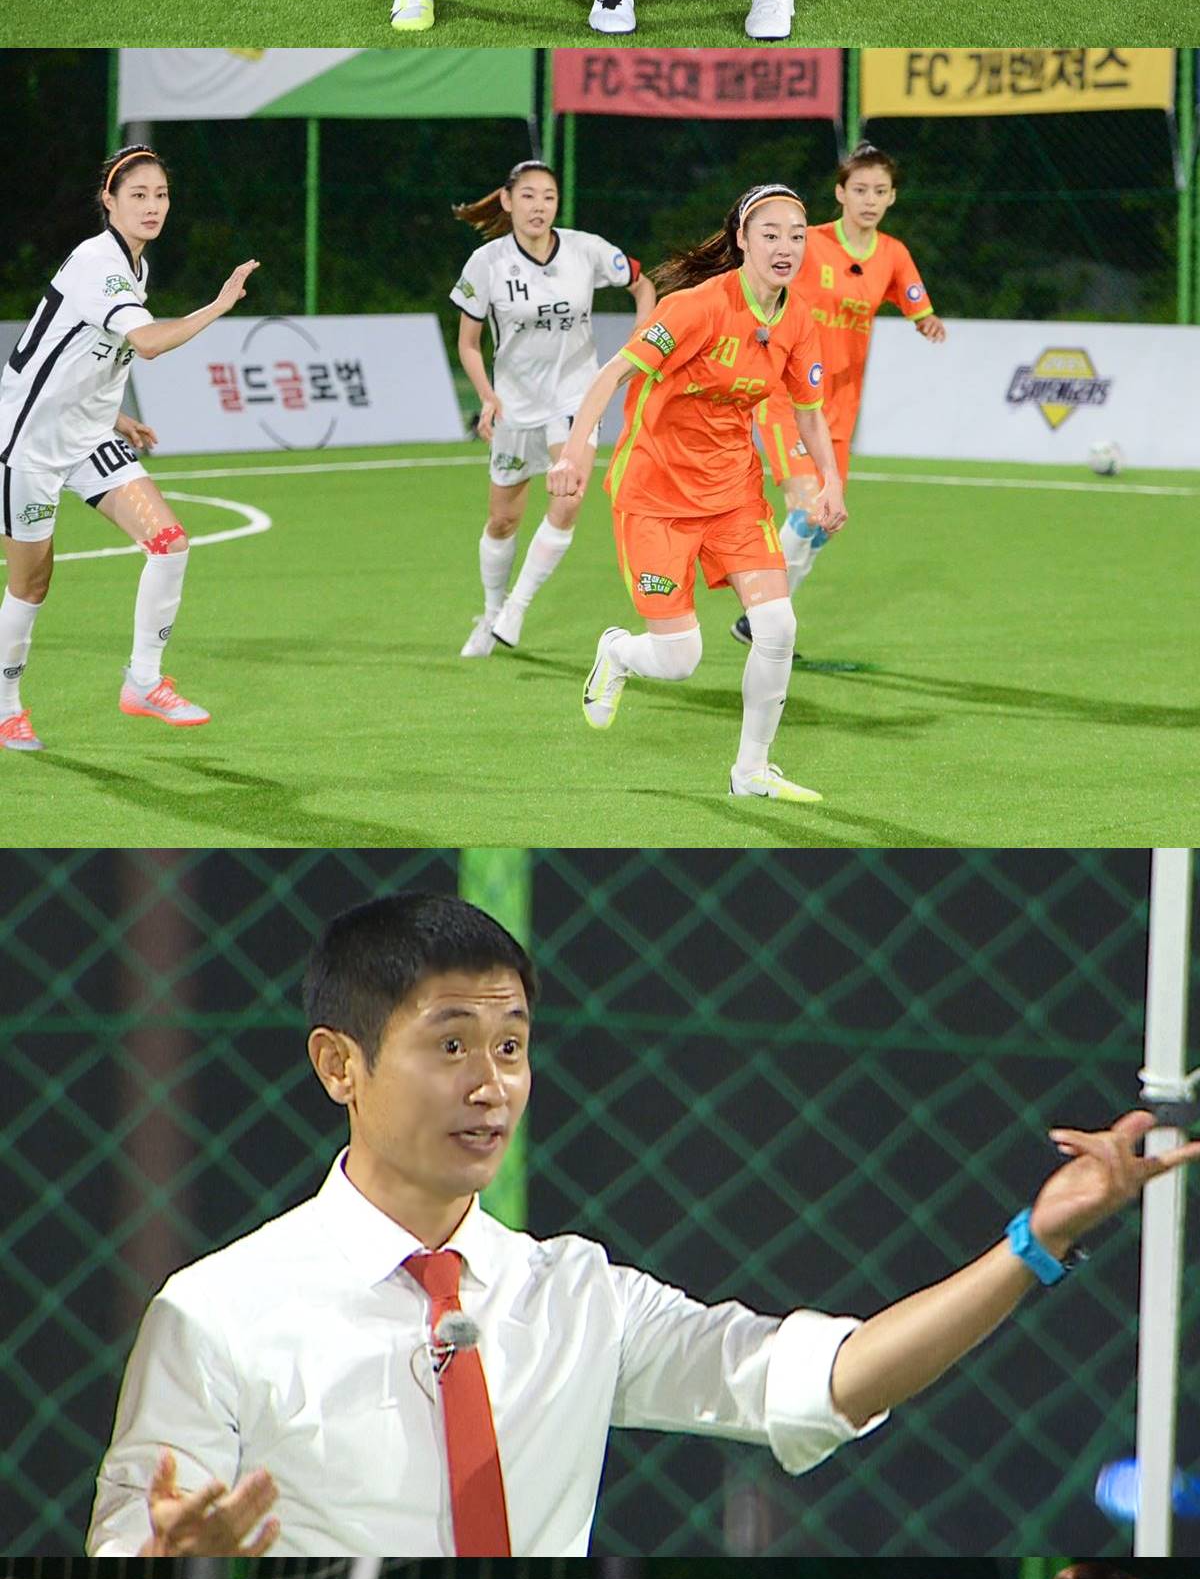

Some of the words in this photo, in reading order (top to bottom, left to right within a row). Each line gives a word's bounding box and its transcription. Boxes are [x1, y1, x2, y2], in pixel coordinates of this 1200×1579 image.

[582, 53, 622, 97] FC
[632, 52, 700, 100] 국대
[714, 53, 821, 102] 패밀리
[905, 52, 951, 98] FC
[506, 279, 530, 302] 14
[821, 264, 835, 290] 8
[537, 301, 571, 318] FC
[709, 335, 740, 368] 10
[207, 357, 372, 414] 필드글로벌
[729, 376, 767, 395] FC
